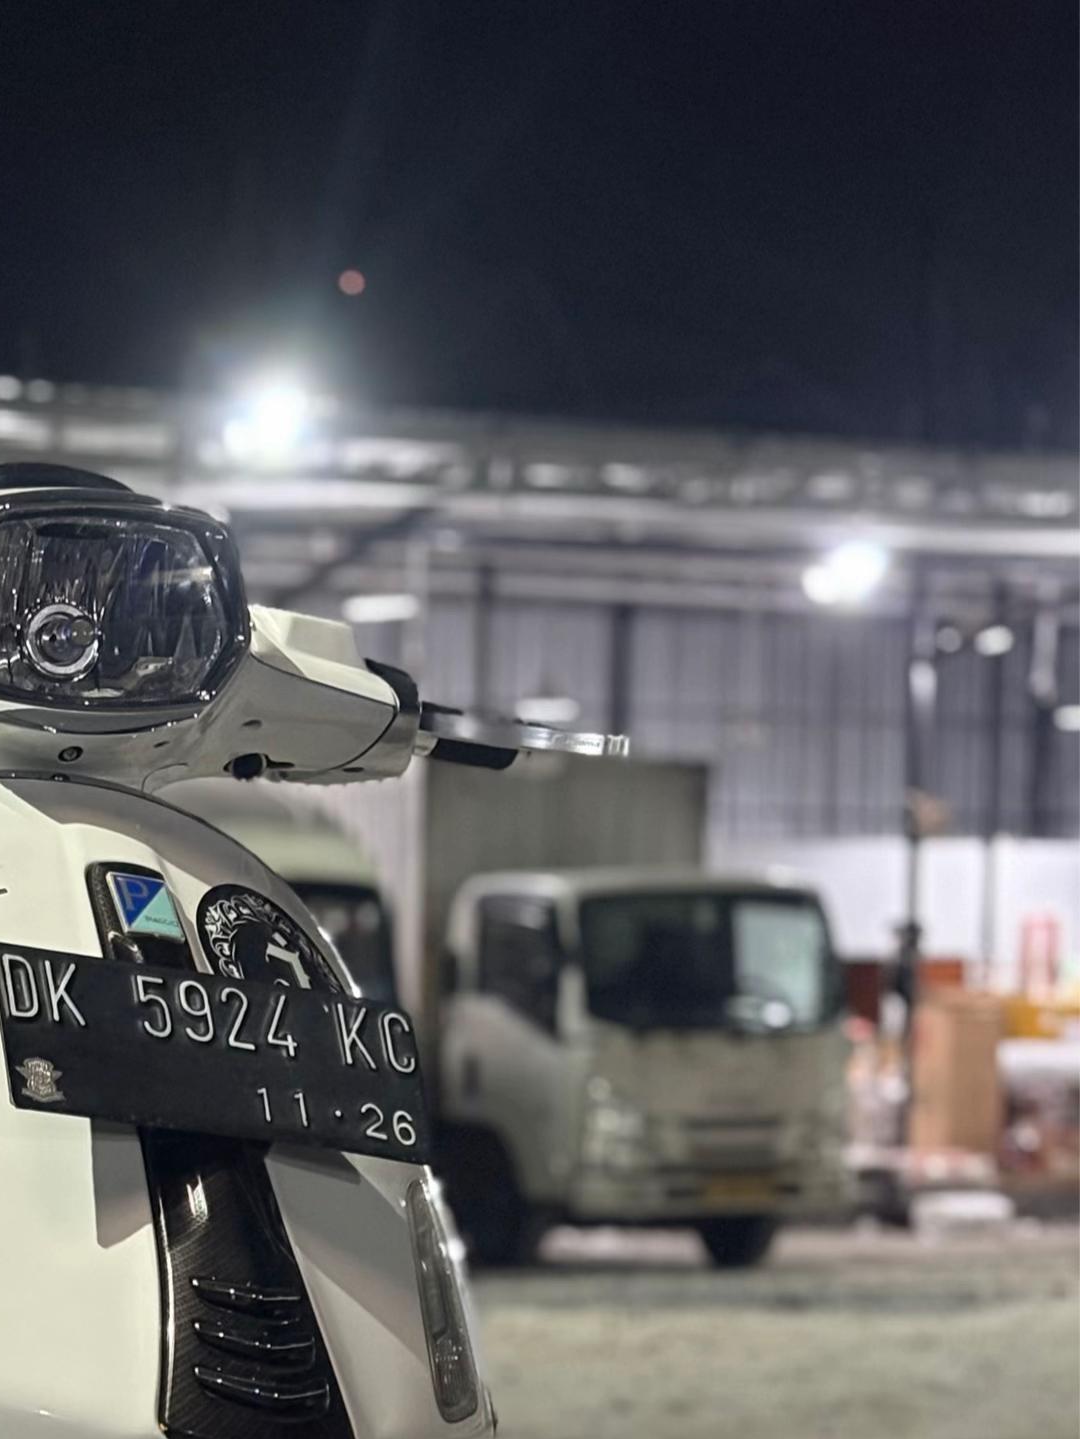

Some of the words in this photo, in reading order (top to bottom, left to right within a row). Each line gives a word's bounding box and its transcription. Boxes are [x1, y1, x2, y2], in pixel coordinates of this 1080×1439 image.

[2, 953, 86, 1027] DK
[136, 974, 298, 1057] 5924
[337, 1002, 416, 1074] KC
